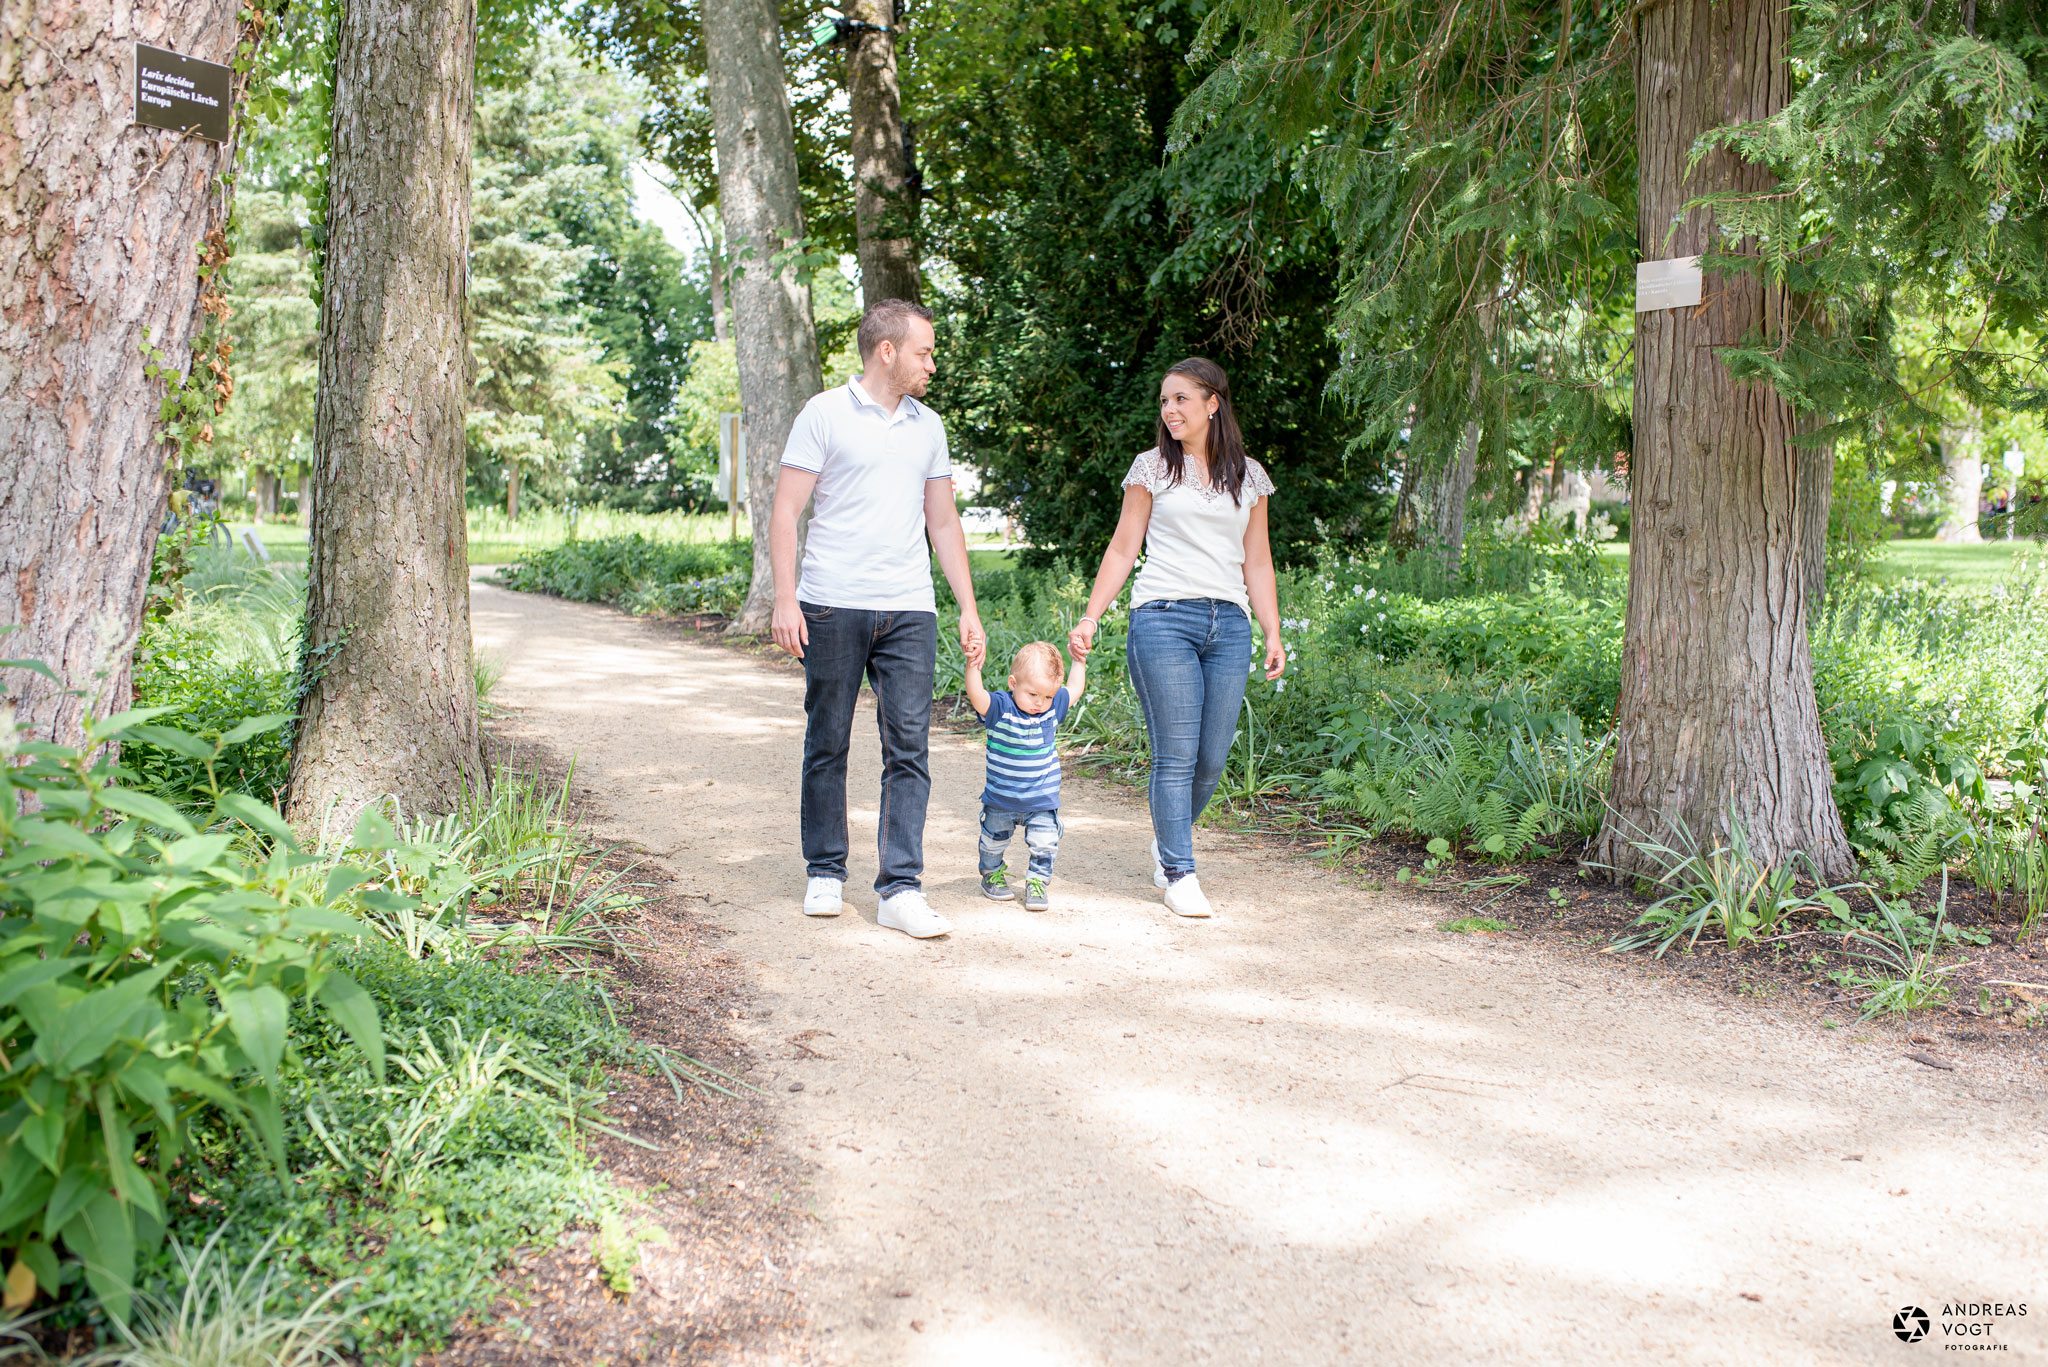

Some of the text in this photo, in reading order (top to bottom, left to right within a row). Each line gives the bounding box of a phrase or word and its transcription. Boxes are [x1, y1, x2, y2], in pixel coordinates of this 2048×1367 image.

[141, 67, 195, 89] Larix decidua
[141, 80, 219, 107] Europäische Lärche
[141, 92, 172, 108] Europa
